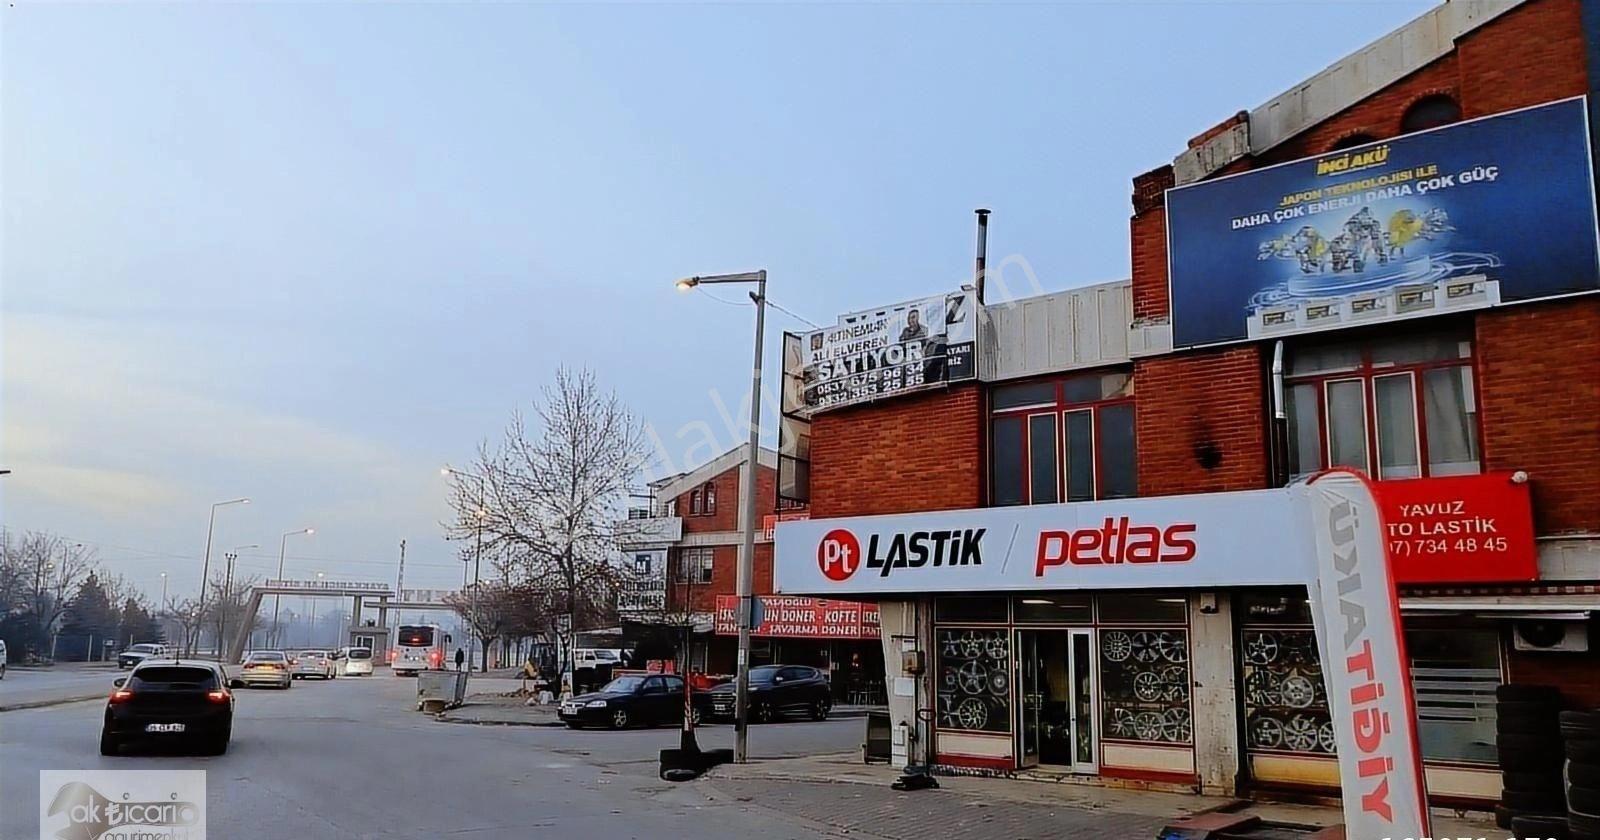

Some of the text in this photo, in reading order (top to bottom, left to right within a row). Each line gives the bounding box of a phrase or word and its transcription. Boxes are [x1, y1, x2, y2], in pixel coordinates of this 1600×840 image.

[1350, 146, 1389, 169] AKÜ
[1231, 213, 1271, 230] DAHA
[1274, 206, 1305, 225] ÇOK
[1365, 184, 1413, 204] DAHA
[1416, 176, 1455, 196] ÇOK
[1458, 165, 1499, 185] GÜÇ
[1279, 188, 1322, 207] JAPON
[833, 335, 888, 357] ELVEREN
[818, 341, 923, 381] SATIYOR
[817, 361, 924, 395] 0537 675 96 34
[883, 379, 901, 391] 25
[1399, 500, 1465, 517] YAVUZ
[1420, 516, 1497, 536] LASTİK
[823, 539, 853, 573] Pt
[1035, 516, 1197, 577] petlas
[1414, 539, 1448, 553] 734
[1454, 538, 1477, 552] 48
[1483, 537, 1508, 552] 45
